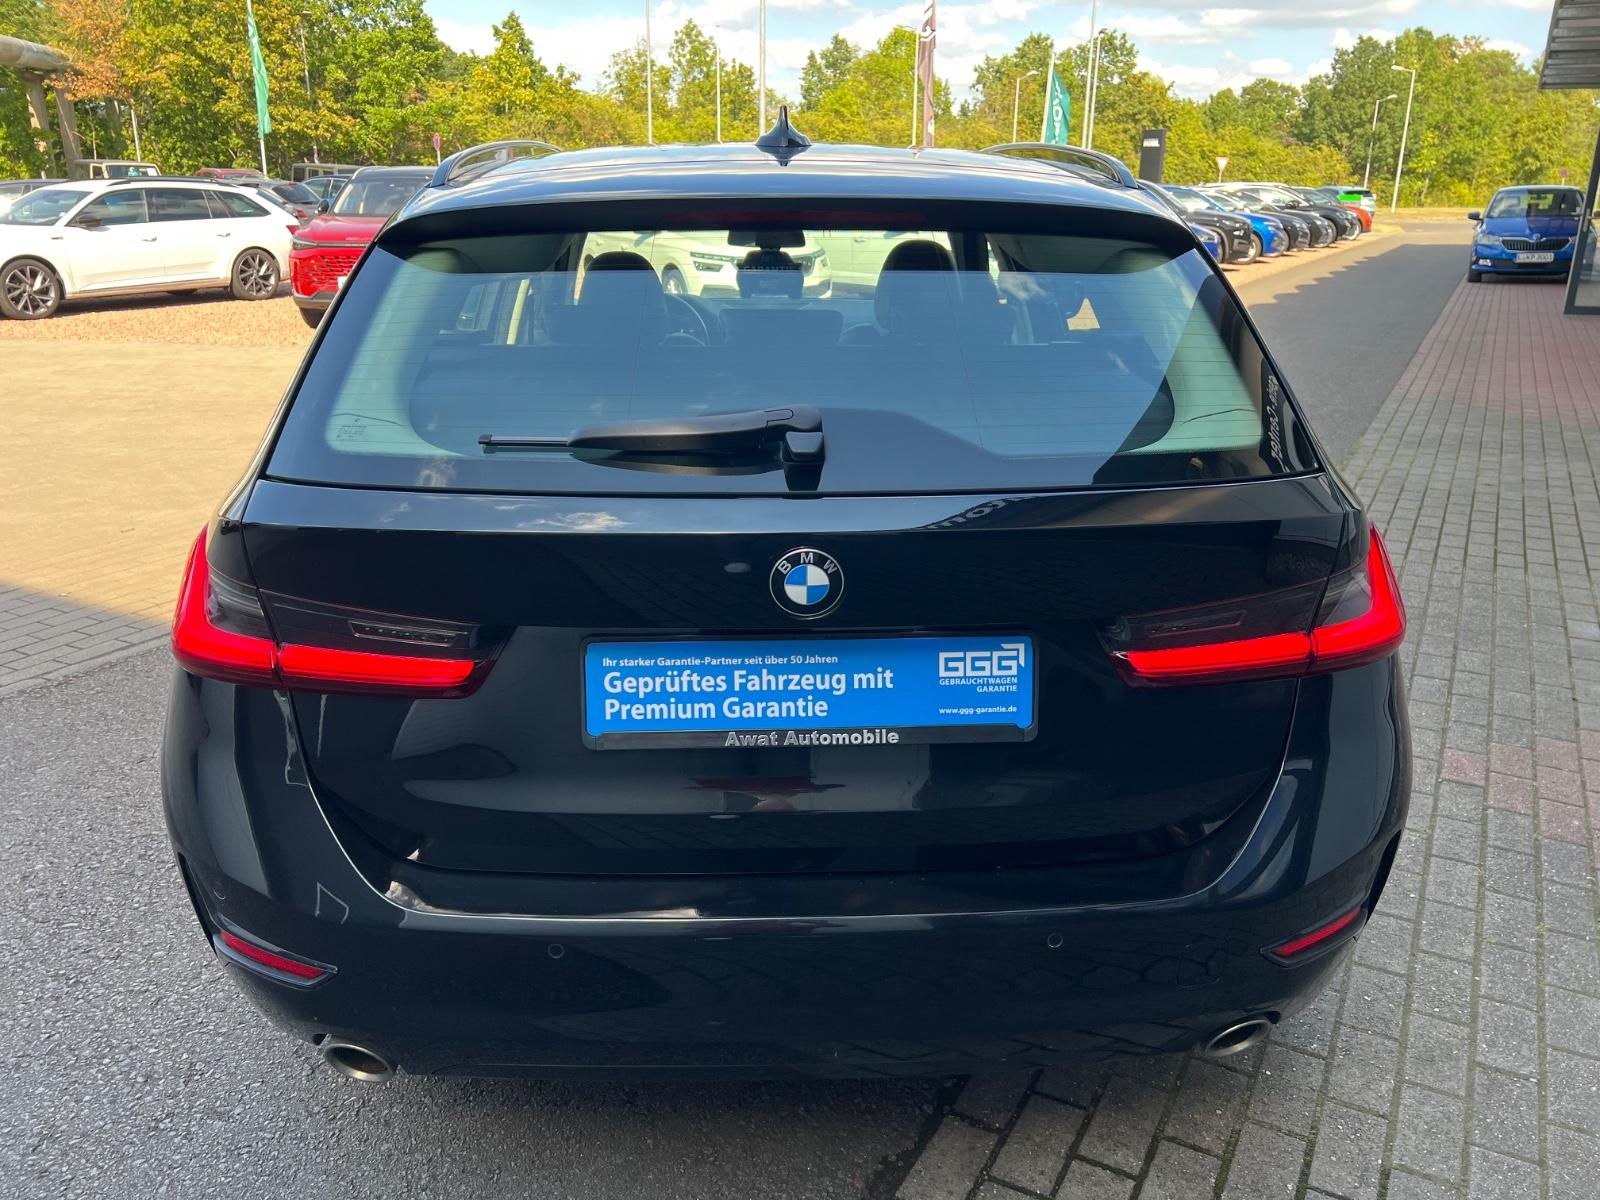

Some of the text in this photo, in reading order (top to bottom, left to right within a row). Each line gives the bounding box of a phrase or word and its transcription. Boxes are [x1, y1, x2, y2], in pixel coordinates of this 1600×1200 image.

[777, 552, 838, 575] BMW
[602, 655, 838, 667] Ihr starker Garantie-Partner seit über 50 Jahren
[938, 650, 1018, 678] GGG
[603, 667, 894, 698] Geprüftes Fahrzeug mit
[939, 677, 1018, 686] GEBRAUCHTWAGEN
[976, 685, 1018, 693] GARANTIE
[604, 695, 828, 720] Premium Garantie
[938, 705, 1018, 715] www.ggg-garantie.de
[724, 729, 900, 747] Awat Automobile
